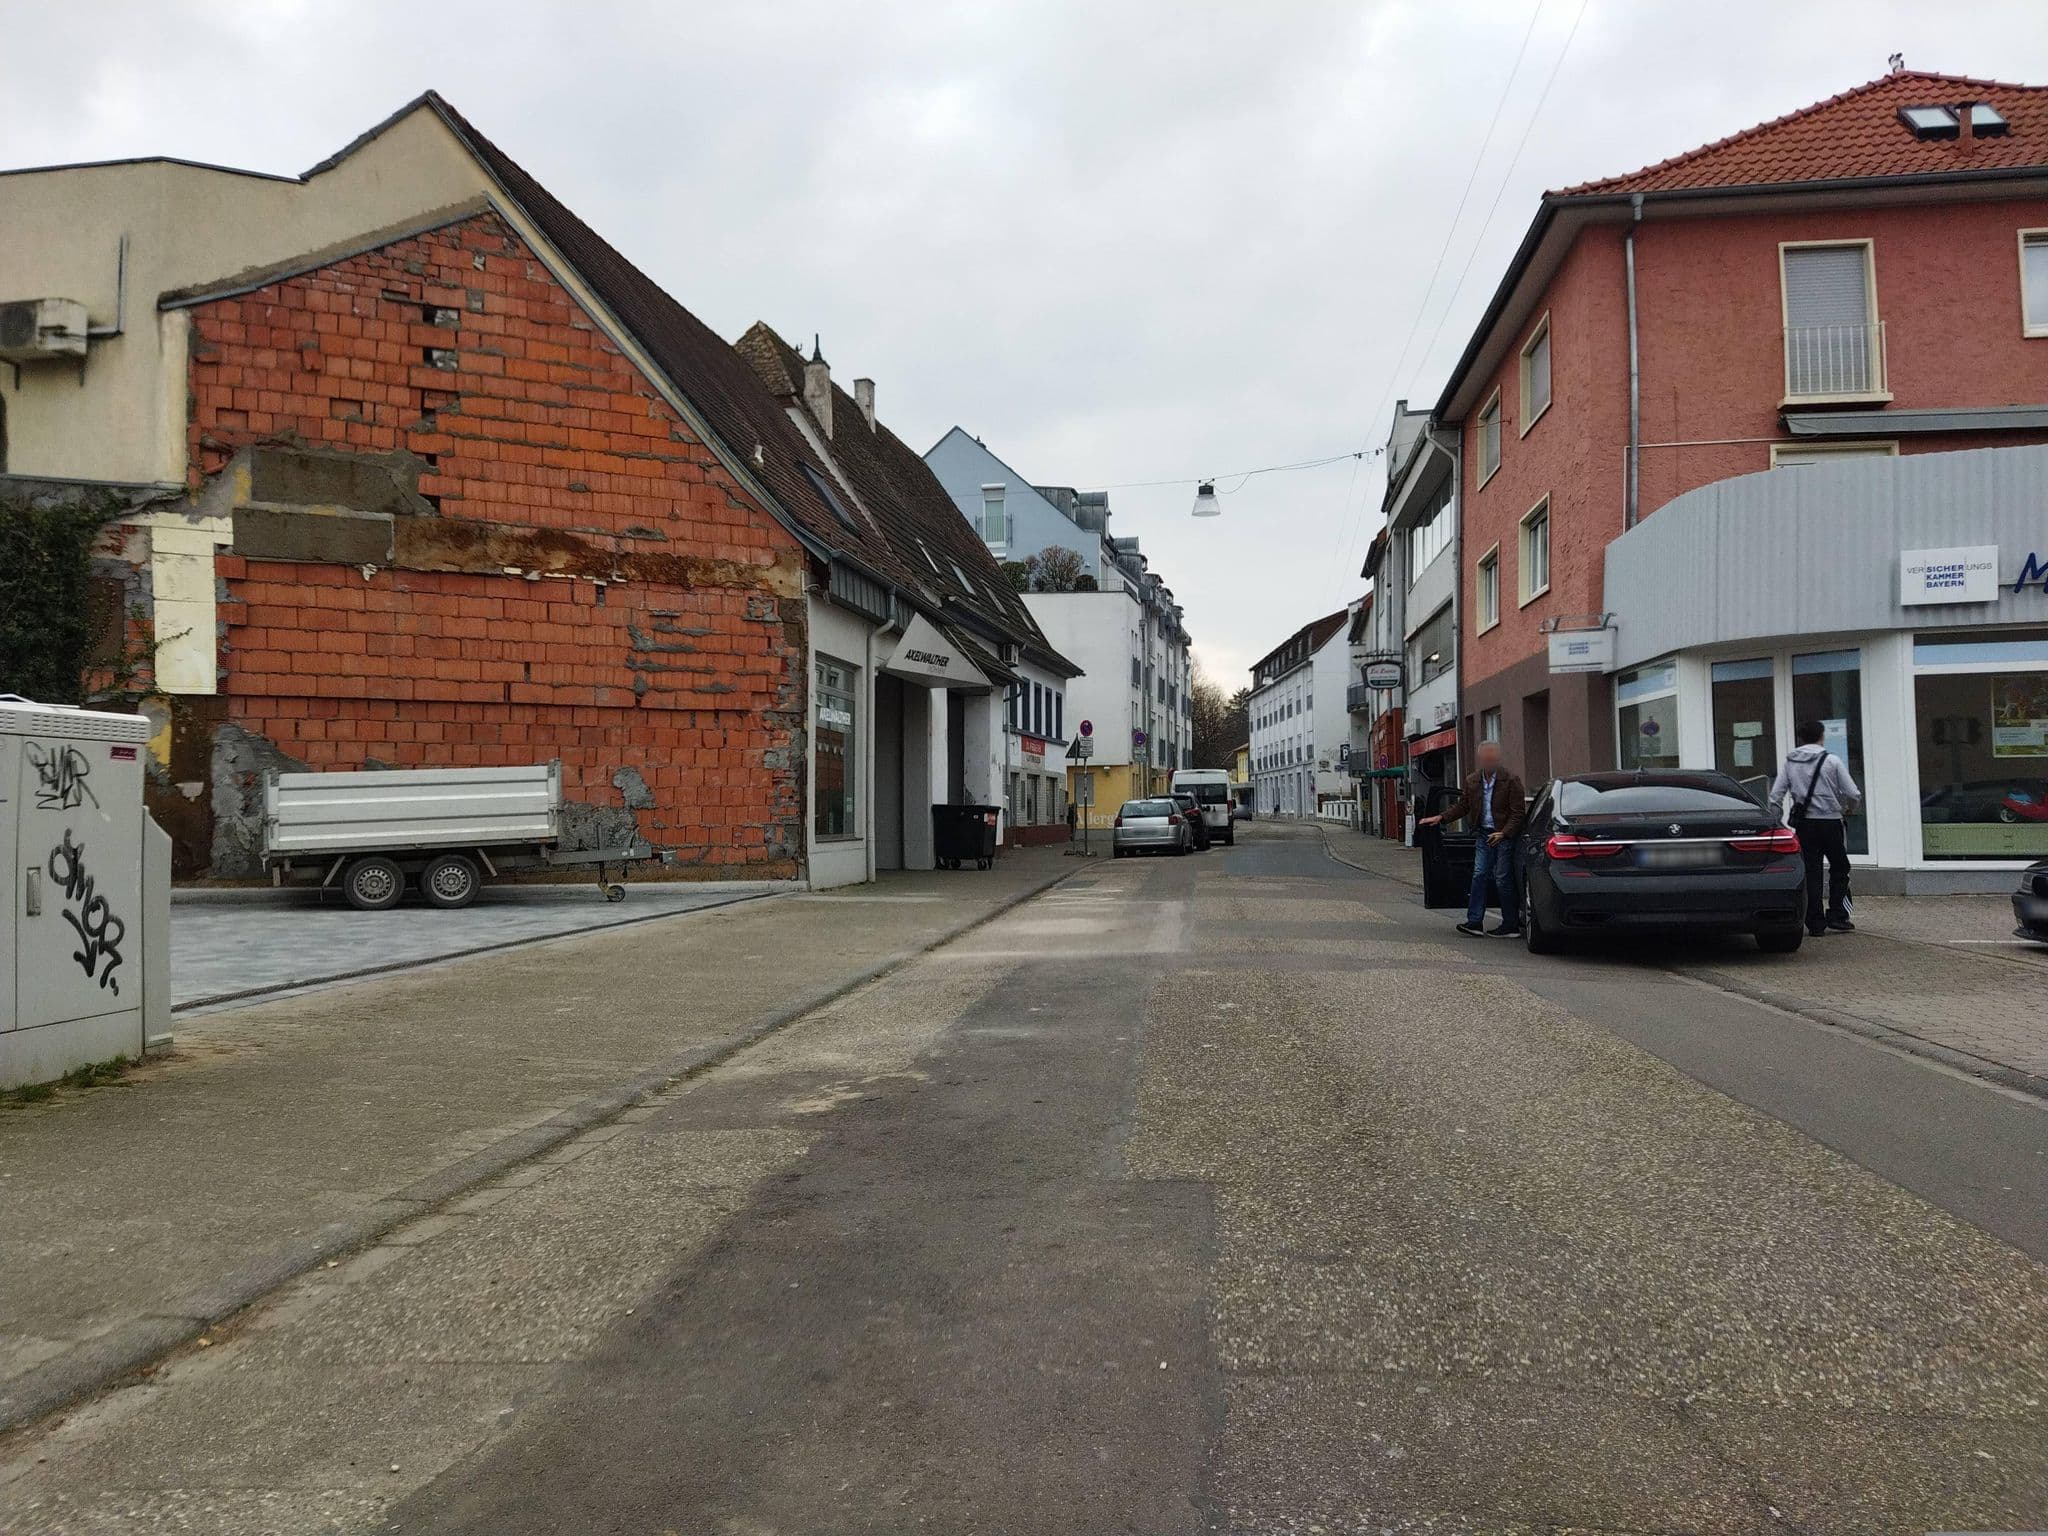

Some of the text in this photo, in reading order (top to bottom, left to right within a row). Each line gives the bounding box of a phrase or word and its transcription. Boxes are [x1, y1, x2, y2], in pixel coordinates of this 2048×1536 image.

[1926, 572, 1964, 581] KAMMER
[1926, 580, 1964, 589] BAYERN
[1343, 748, 1349, 760] P
